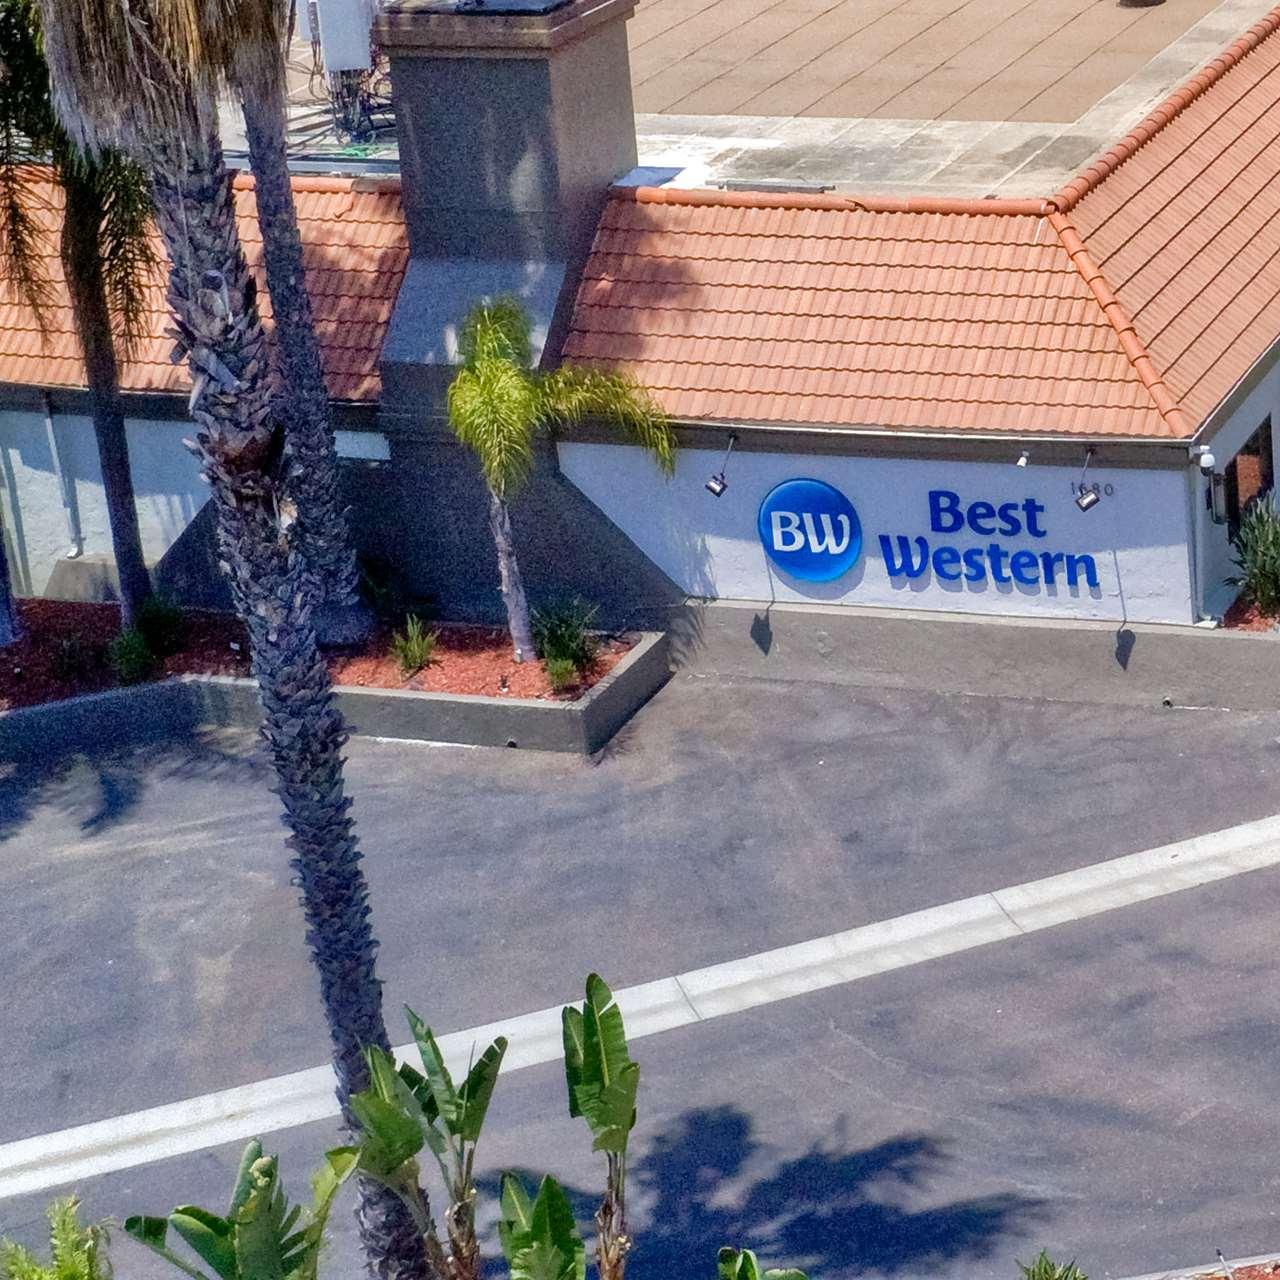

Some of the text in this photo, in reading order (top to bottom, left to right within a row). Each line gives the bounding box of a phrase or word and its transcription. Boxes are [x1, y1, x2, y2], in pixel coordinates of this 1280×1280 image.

[770, 510, 851, 555] BW
[928, 489, 1047, 538] Best
[879, 534, 1100, 588] Western
